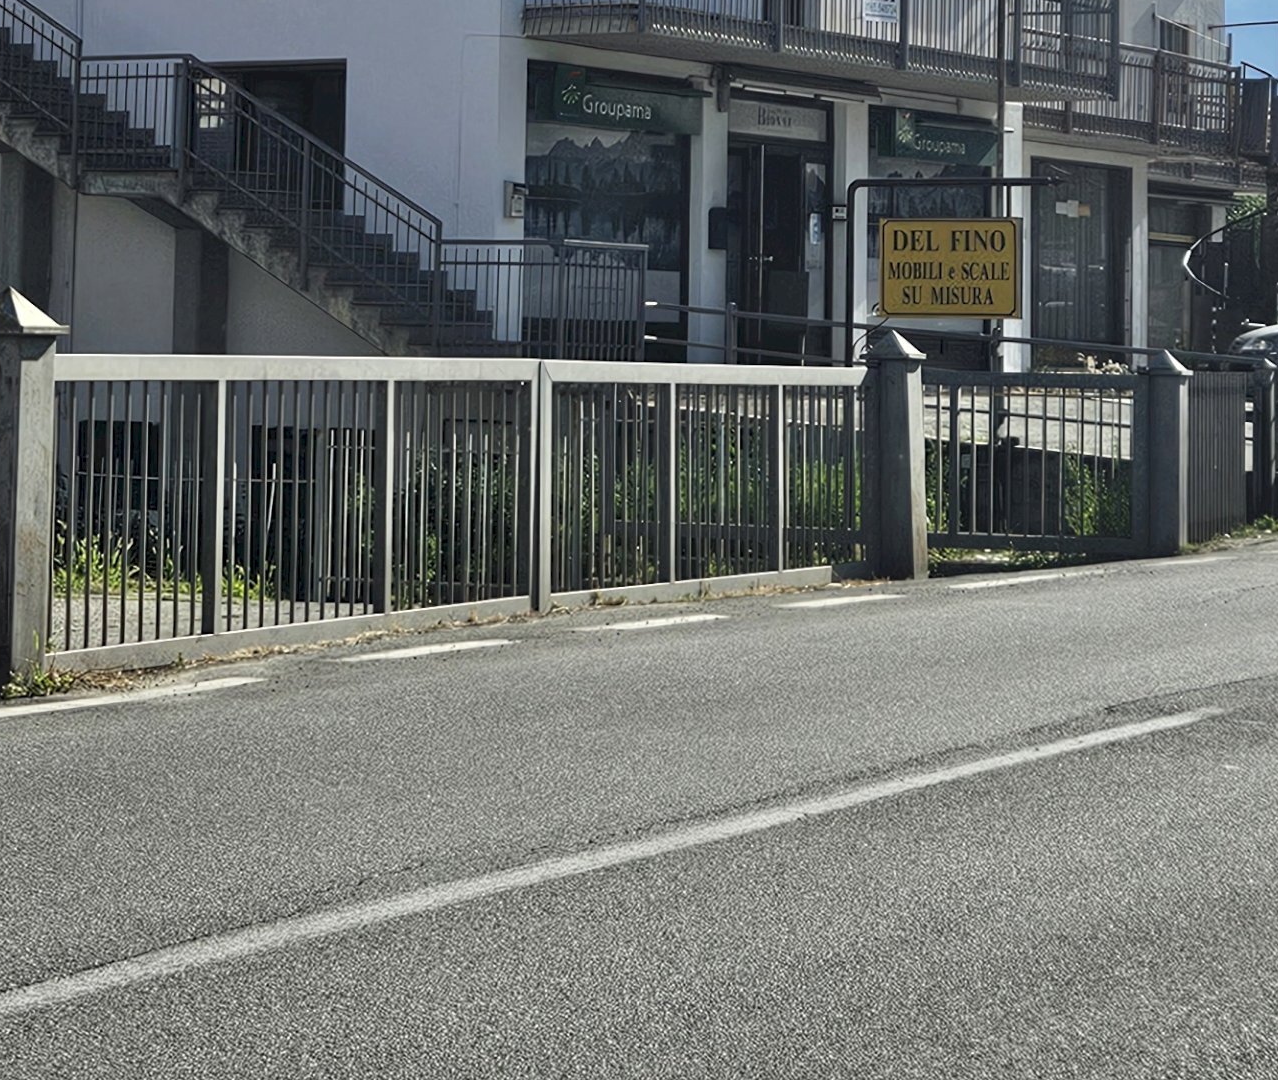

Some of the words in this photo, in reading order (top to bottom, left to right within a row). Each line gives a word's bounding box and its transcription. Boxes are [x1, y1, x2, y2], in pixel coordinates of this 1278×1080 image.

[582, 94, 652, 120] Groupama
[913, 133, 966, 156] Groupama
[893, 229, 940, 252] DEL
[950, 229, 1006, 252] FINO
[888, 261, 943, 280] MOBILI
[948, 266, 956, 280] e
[961, 262, 1010, 281] SCALE
[902, 286, 922, 305] SU
[931, 286, 994, 305] MISURA
